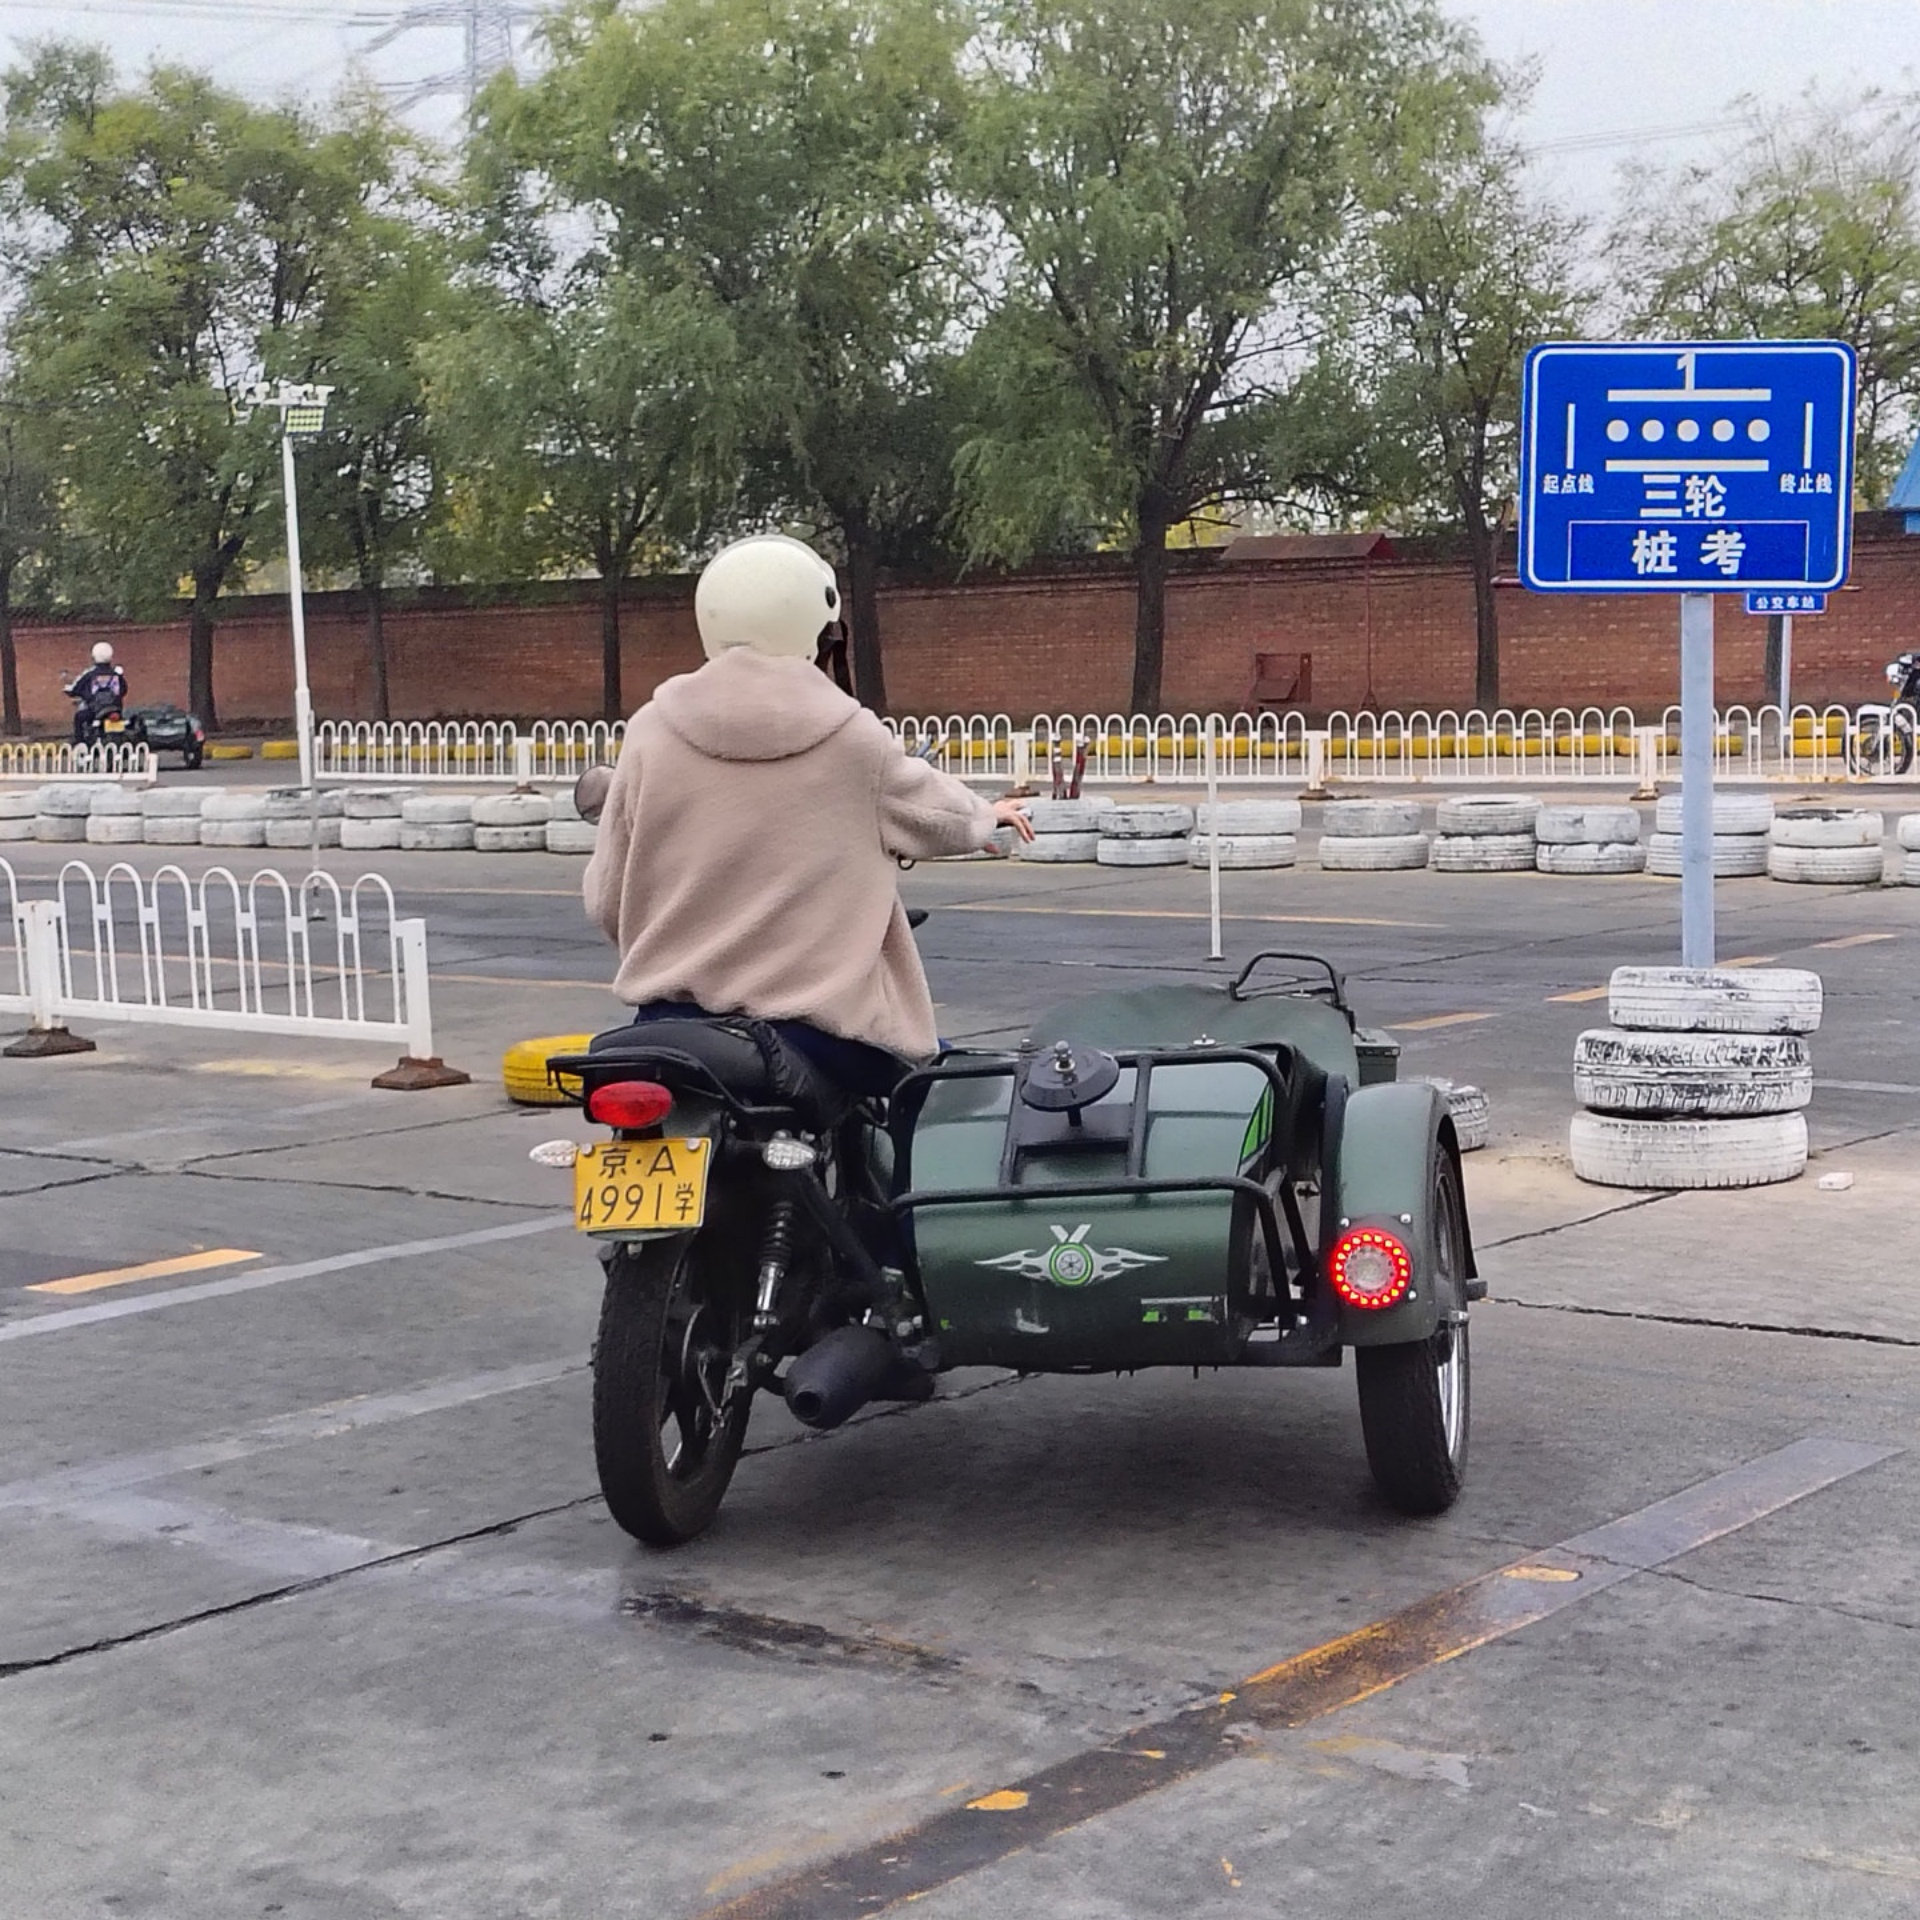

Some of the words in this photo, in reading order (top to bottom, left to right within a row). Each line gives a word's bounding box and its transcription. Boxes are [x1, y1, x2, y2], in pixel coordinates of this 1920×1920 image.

[1676, 352, 1697, 390] 1
[1543, 473, 1595, 495] 起点线
[1640, 474, 1728, 518] 三轮
[1779, 472, 1833, 494] 终止线
[1631, 529, 1746, 575] 桩考
[1755, 595, 1815, 609] 公交车站
[580, 1182, 694, 1225] 4991学
